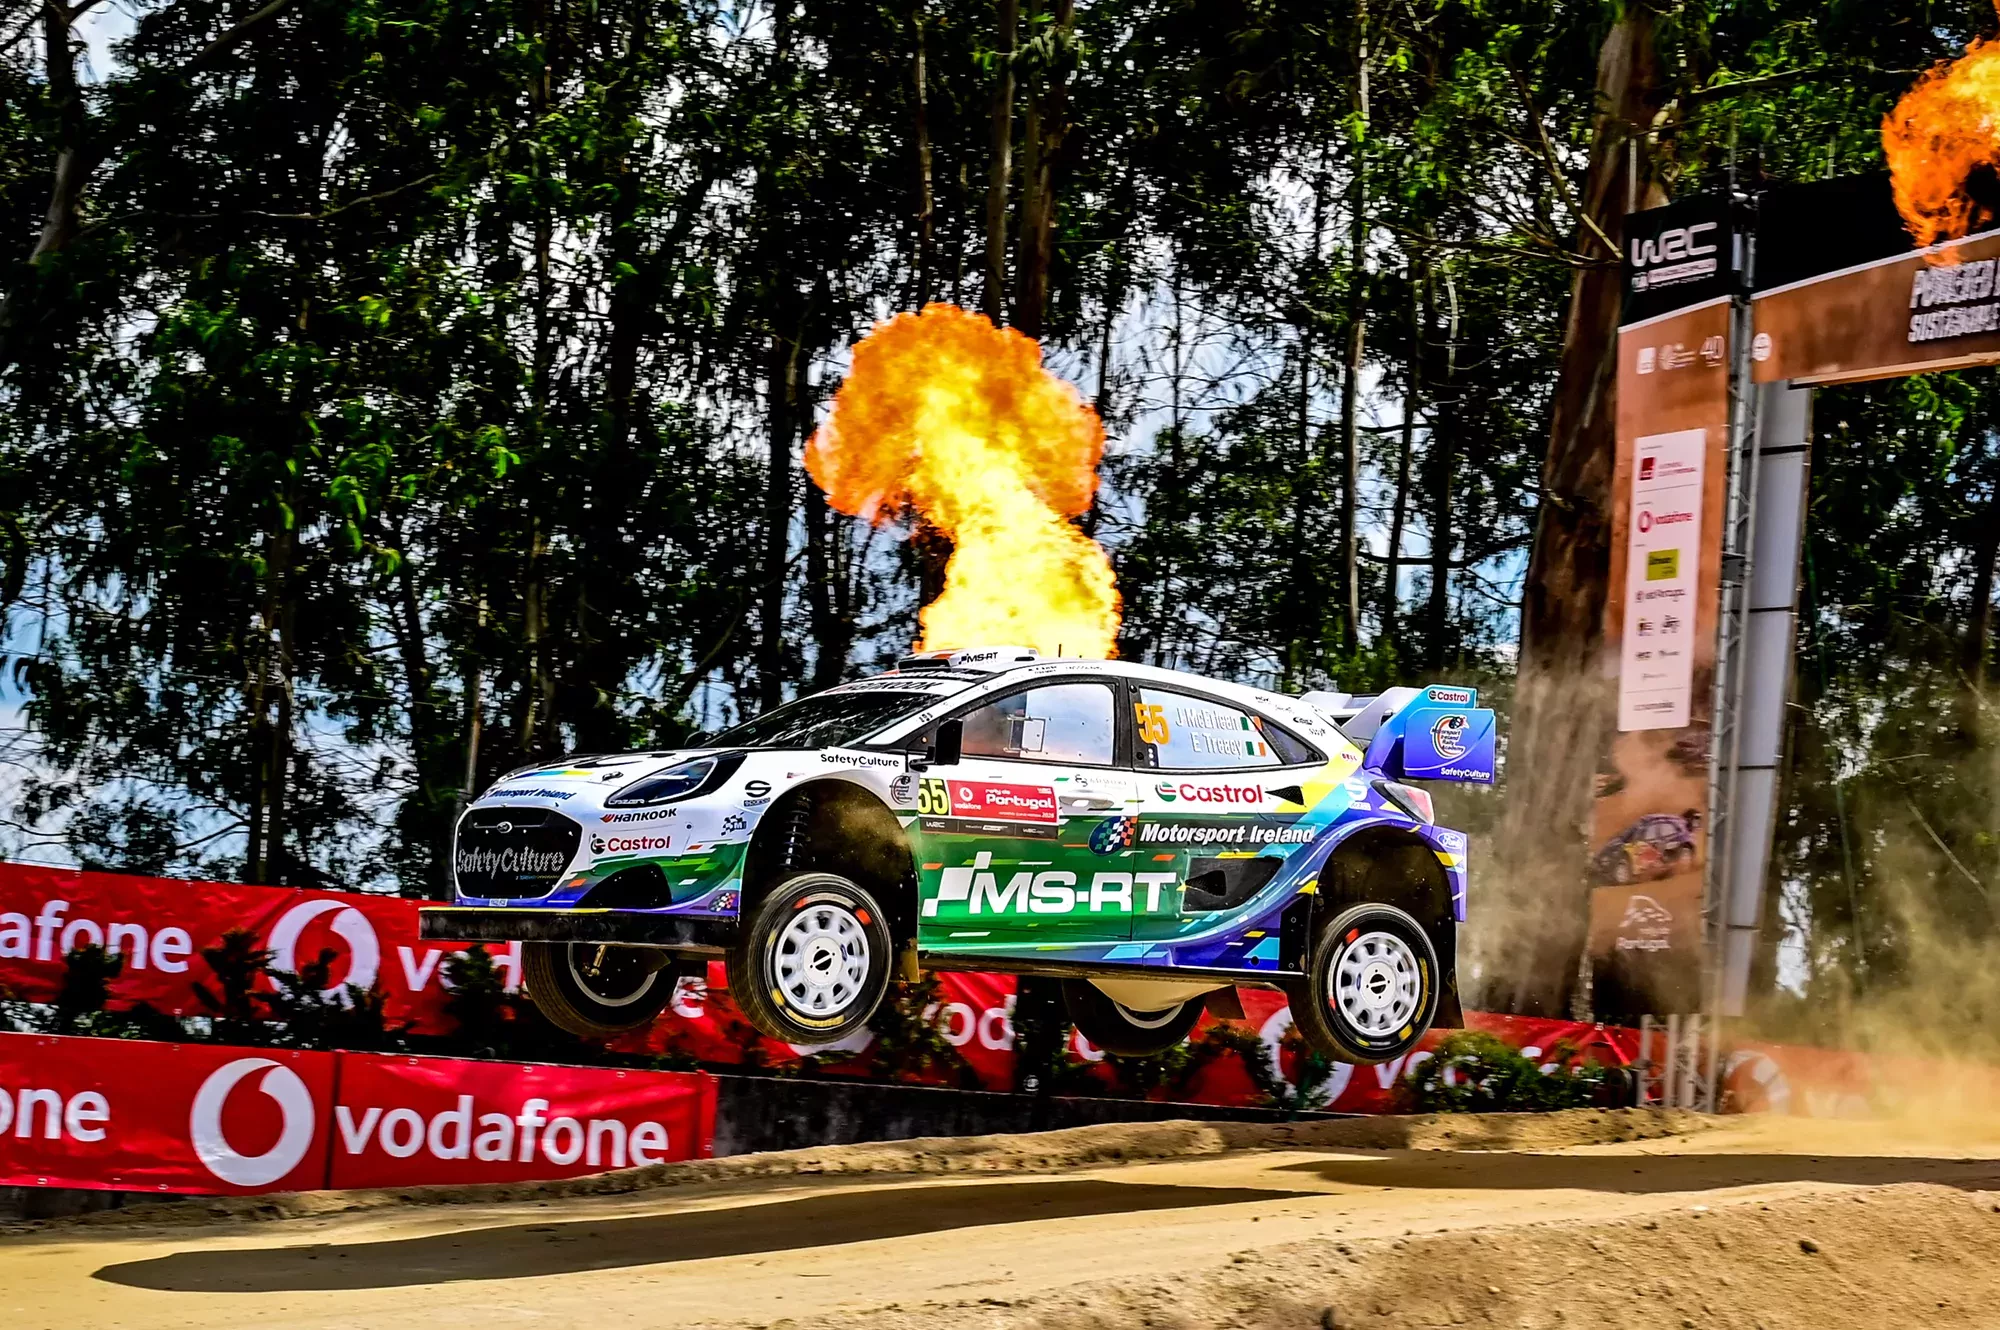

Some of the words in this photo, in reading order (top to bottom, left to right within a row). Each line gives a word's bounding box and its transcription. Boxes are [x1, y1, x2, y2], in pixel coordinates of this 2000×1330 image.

[1631, 222, 1717, 267] WRC
[1437, 692, 1468, 702] Castrol
[1134, 703, 1171, 745] 55
[1192, 732, 1202, 752] E
[820, 753, 900, 767] SafetyCulture
[1440, 766, 1491, 779] SafetyCulture
[918, 778, 949, 815] 55
[985, 793, 1055, 811] Portugal
[1179, 783, 1263, 804] Castrol
[613, 808, 677, 823] HANKOOK
[608, 836, 671, 852] Castrol
[1139, 823, 1247, 844] Motorsport
[1249, 824, 1316, 844] Ireland
[457, 847, 565, 880] SafetyCulture
[969, 871, 1177, 914] MS-RT
[334, 1094, 670, 1168] vodafone
